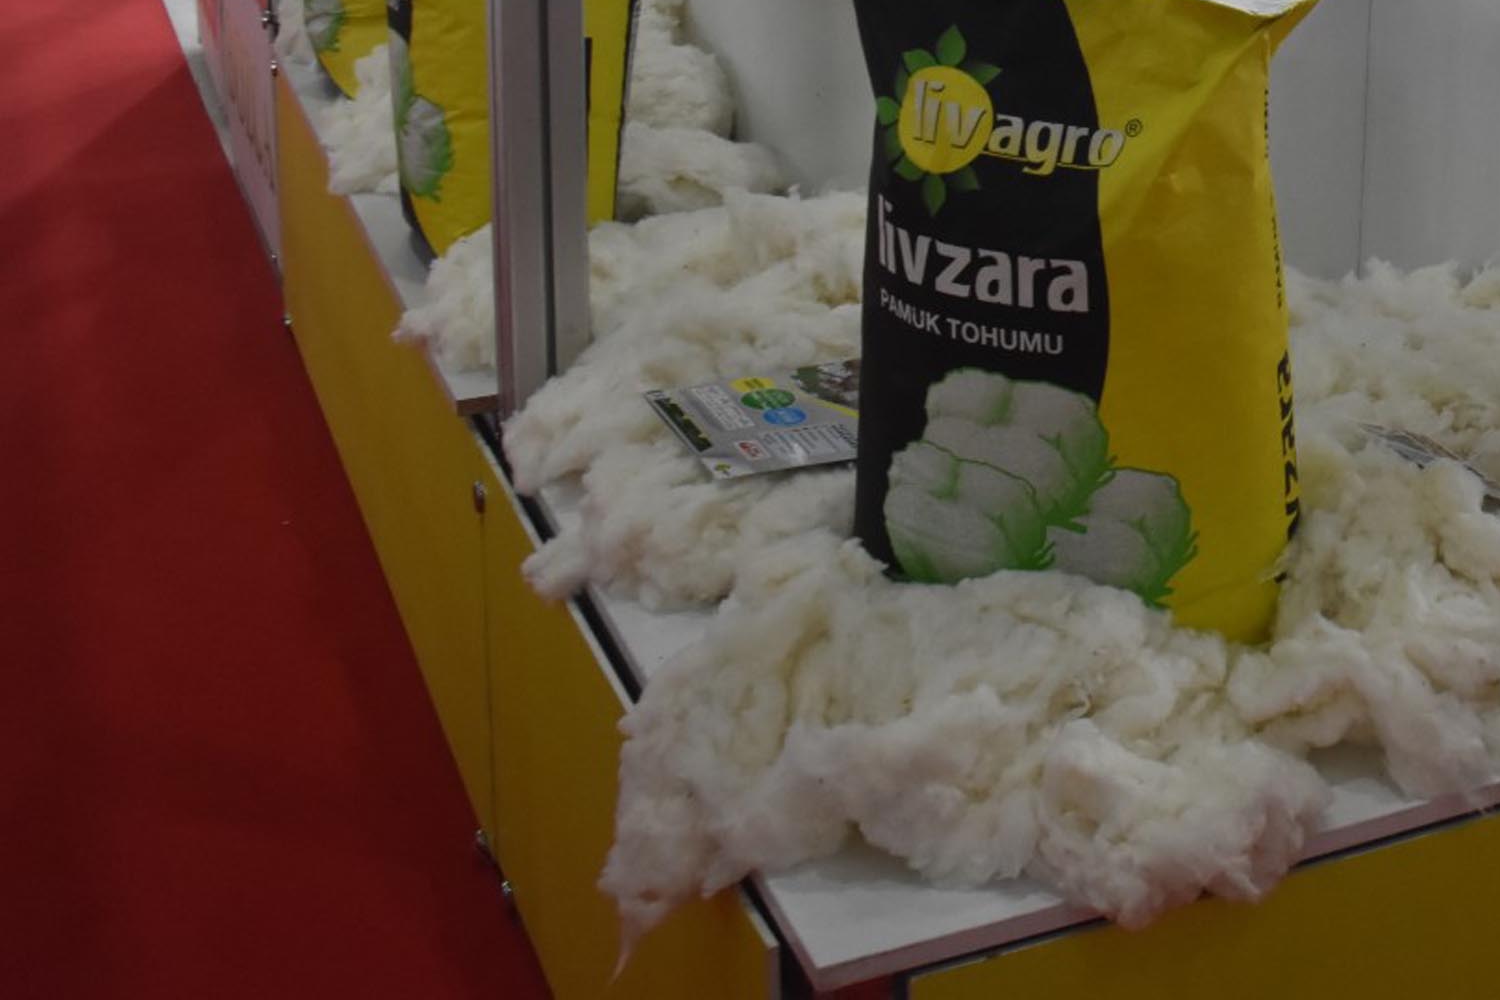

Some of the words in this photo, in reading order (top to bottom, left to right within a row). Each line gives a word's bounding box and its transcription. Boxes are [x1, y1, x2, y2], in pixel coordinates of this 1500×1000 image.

[877, 193, 1091, 313] livzara
[879, 286, 942, 337] PAMUK
[946, 316, 1065, 356] TOHUMU
